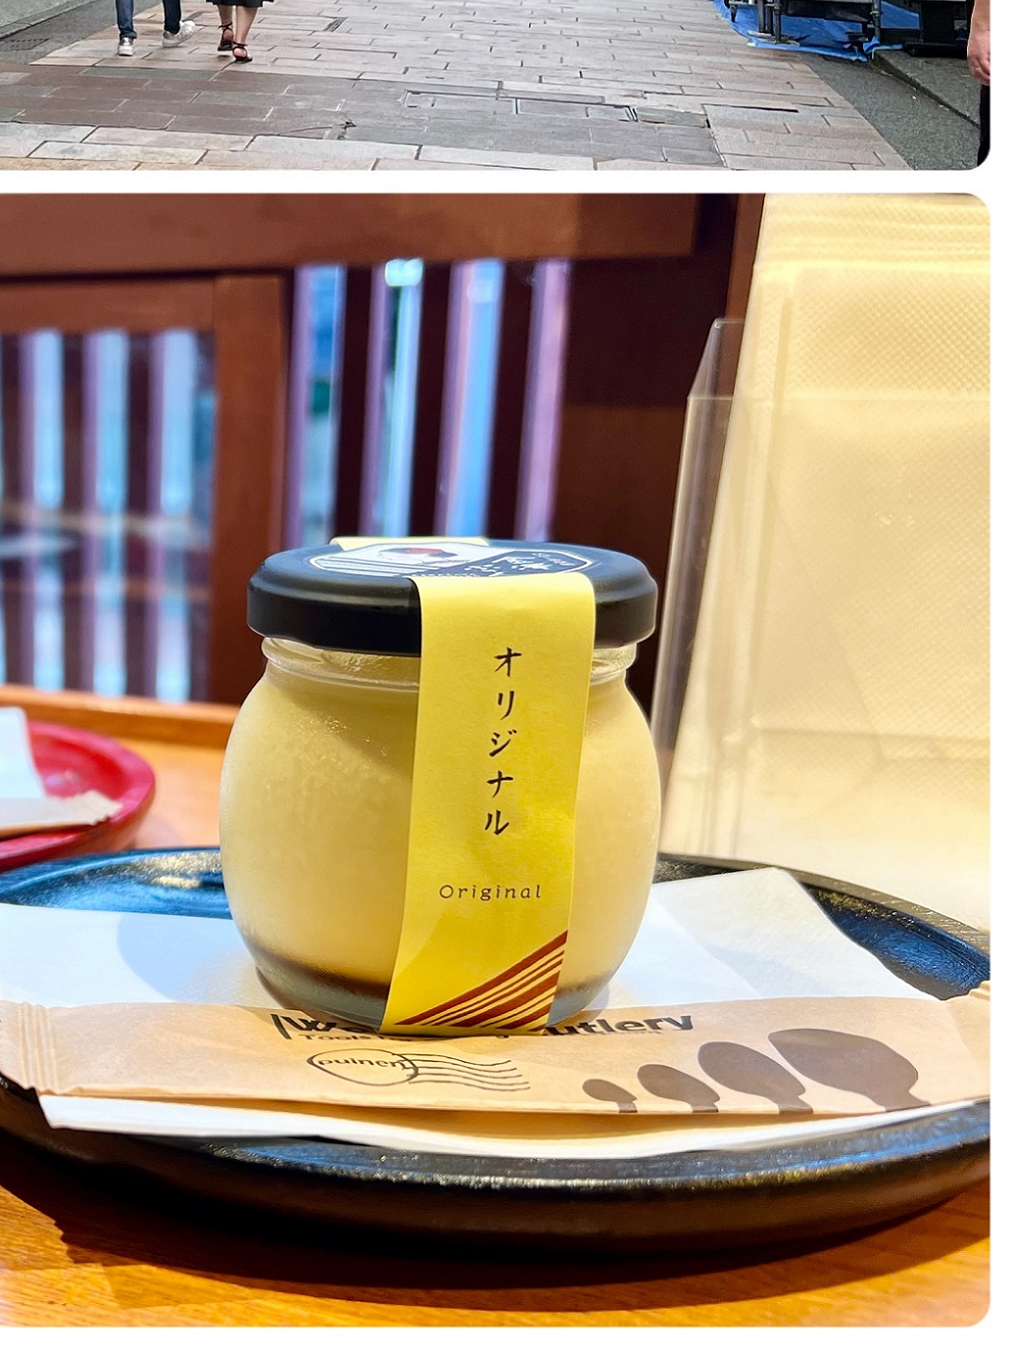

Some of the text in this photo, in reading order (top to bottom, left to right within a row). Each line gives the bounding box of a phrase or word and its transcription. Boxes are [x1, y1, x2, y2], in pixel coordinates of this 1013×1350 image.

[484, 646, 523, 836] オリジナル
[439, 884, 541, 902] Original
[541, 1014, 695, 1037] utlery
